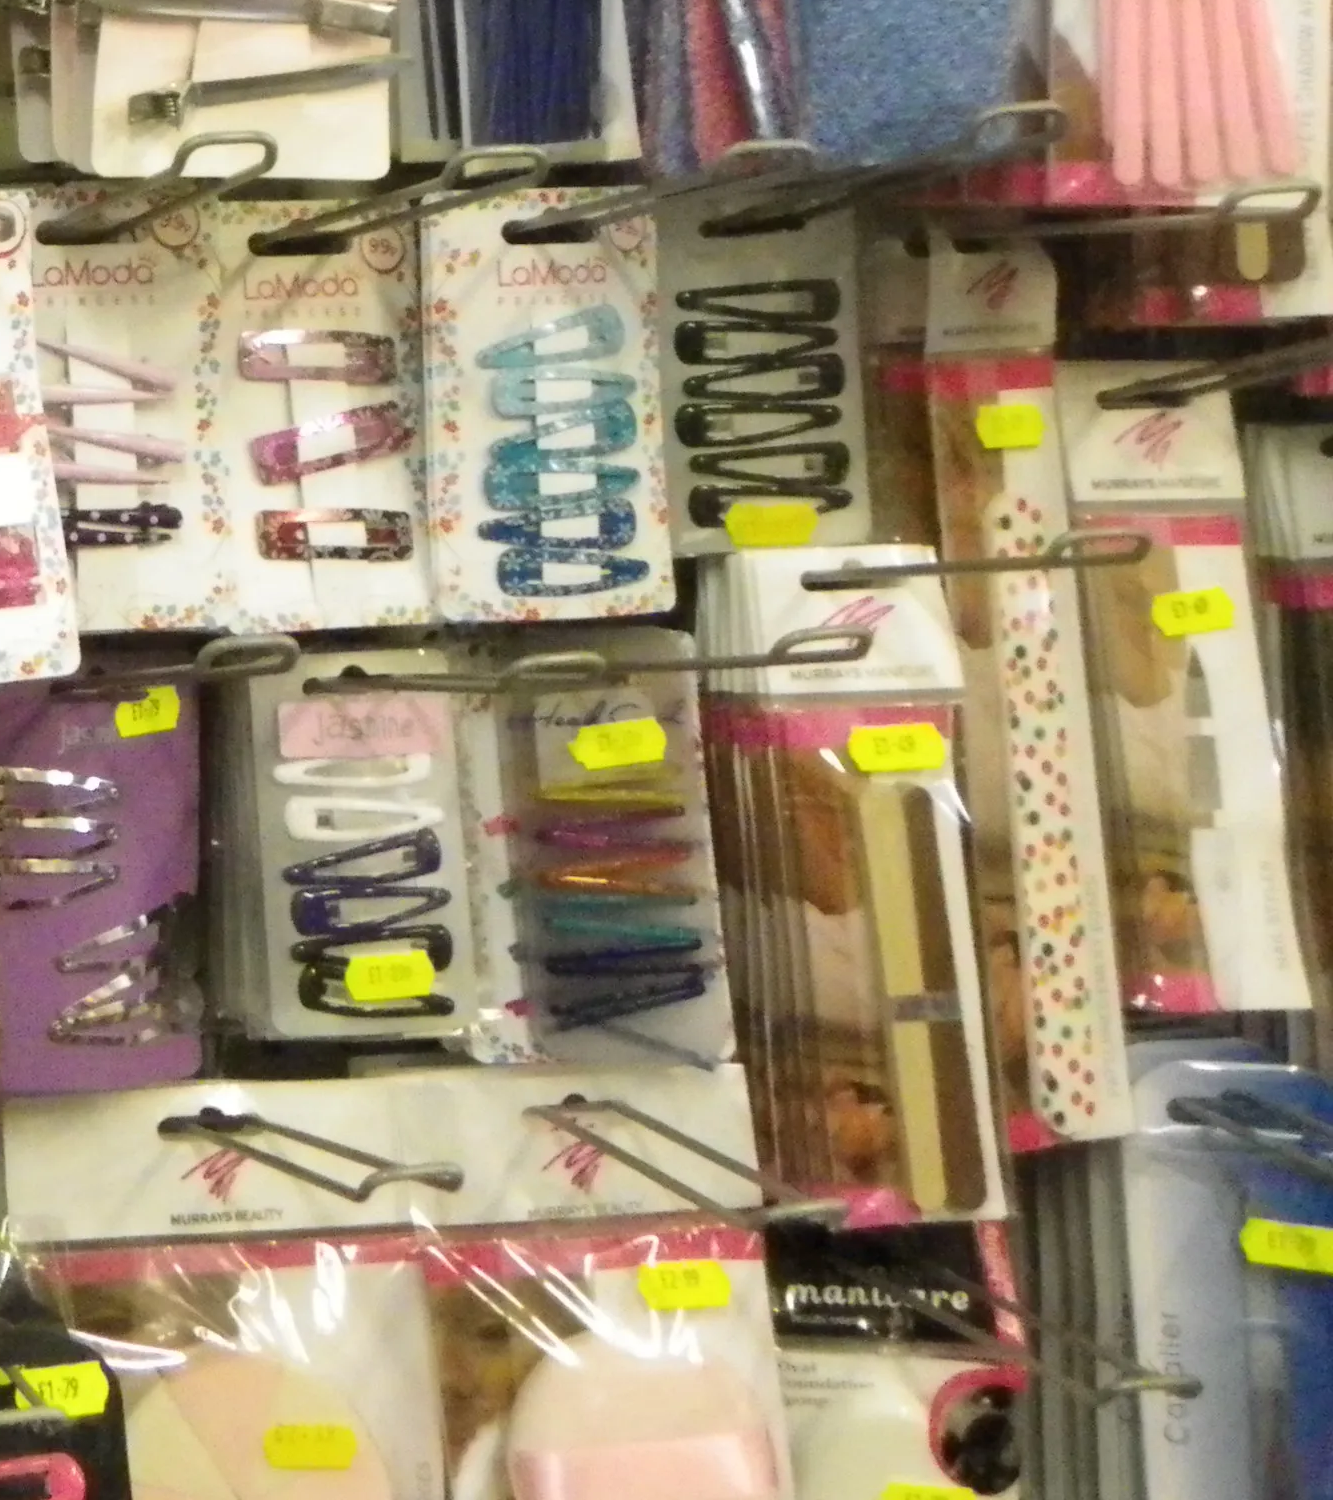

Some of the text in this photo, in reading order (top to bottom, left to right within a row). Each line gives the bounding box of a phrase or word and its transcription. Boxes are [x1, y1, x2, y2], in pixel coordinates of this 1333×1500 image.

[33, 256, 154, 288] LaModa
[244, 269, 358, 300] LaModa
[497, 257, 607, 288] LaModa
[170, 1207, 284, 1226] MURRAYS BEAUTY
